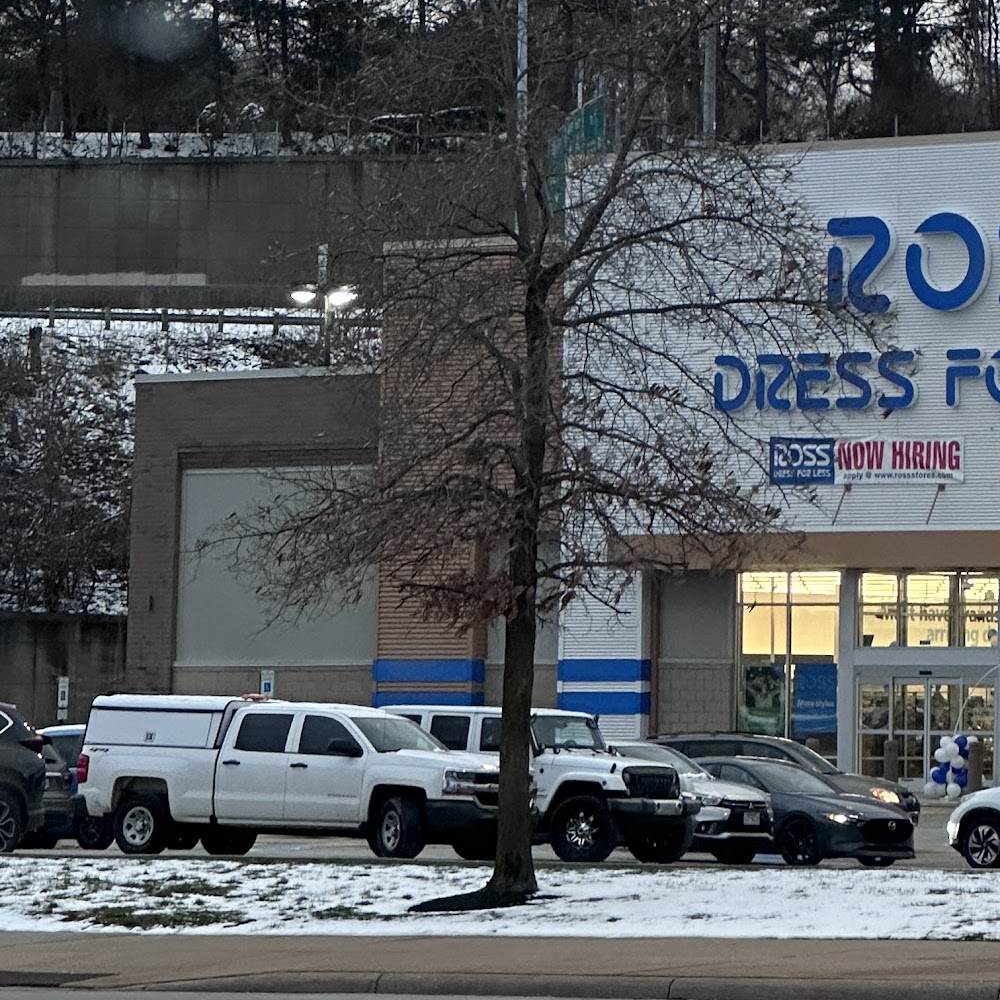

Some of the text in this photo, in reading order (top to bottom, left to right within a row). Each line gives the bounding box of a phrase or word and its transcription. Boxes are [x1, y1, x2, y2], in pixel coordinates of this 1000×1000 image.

[714, 350, 916, 411] DRESS
[774, 442, 831, 467] ROSS
[838, 440, 961, 470] NOW HIRING
[812, 468, 831, 478] LESS
[843, 472, 863, 480] apply
